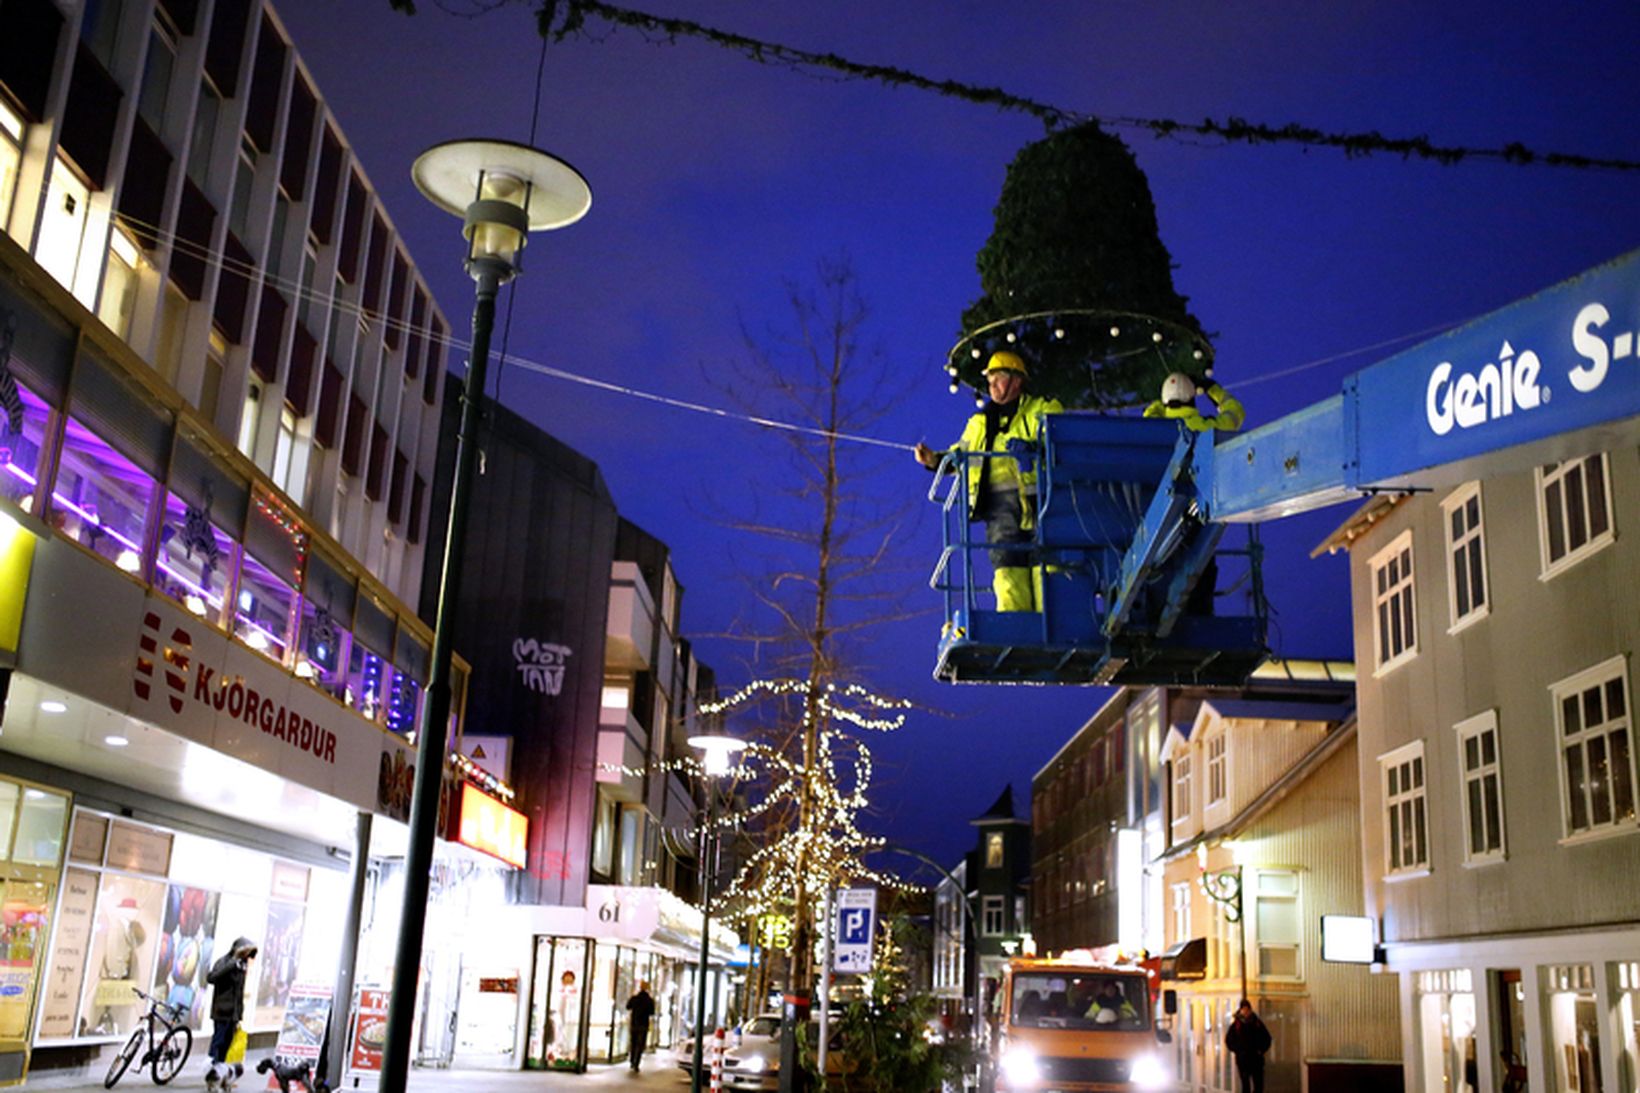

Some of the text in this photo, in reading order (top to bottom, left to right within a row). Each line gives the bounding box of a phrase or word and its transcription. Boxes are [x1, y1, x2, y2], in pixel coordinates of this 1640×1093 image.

[1426, 302, 1640, 436] Genie S-
[194, 666, 338, 763] KJÖRGARÐUR
[598, 900, 621, 923] 61
